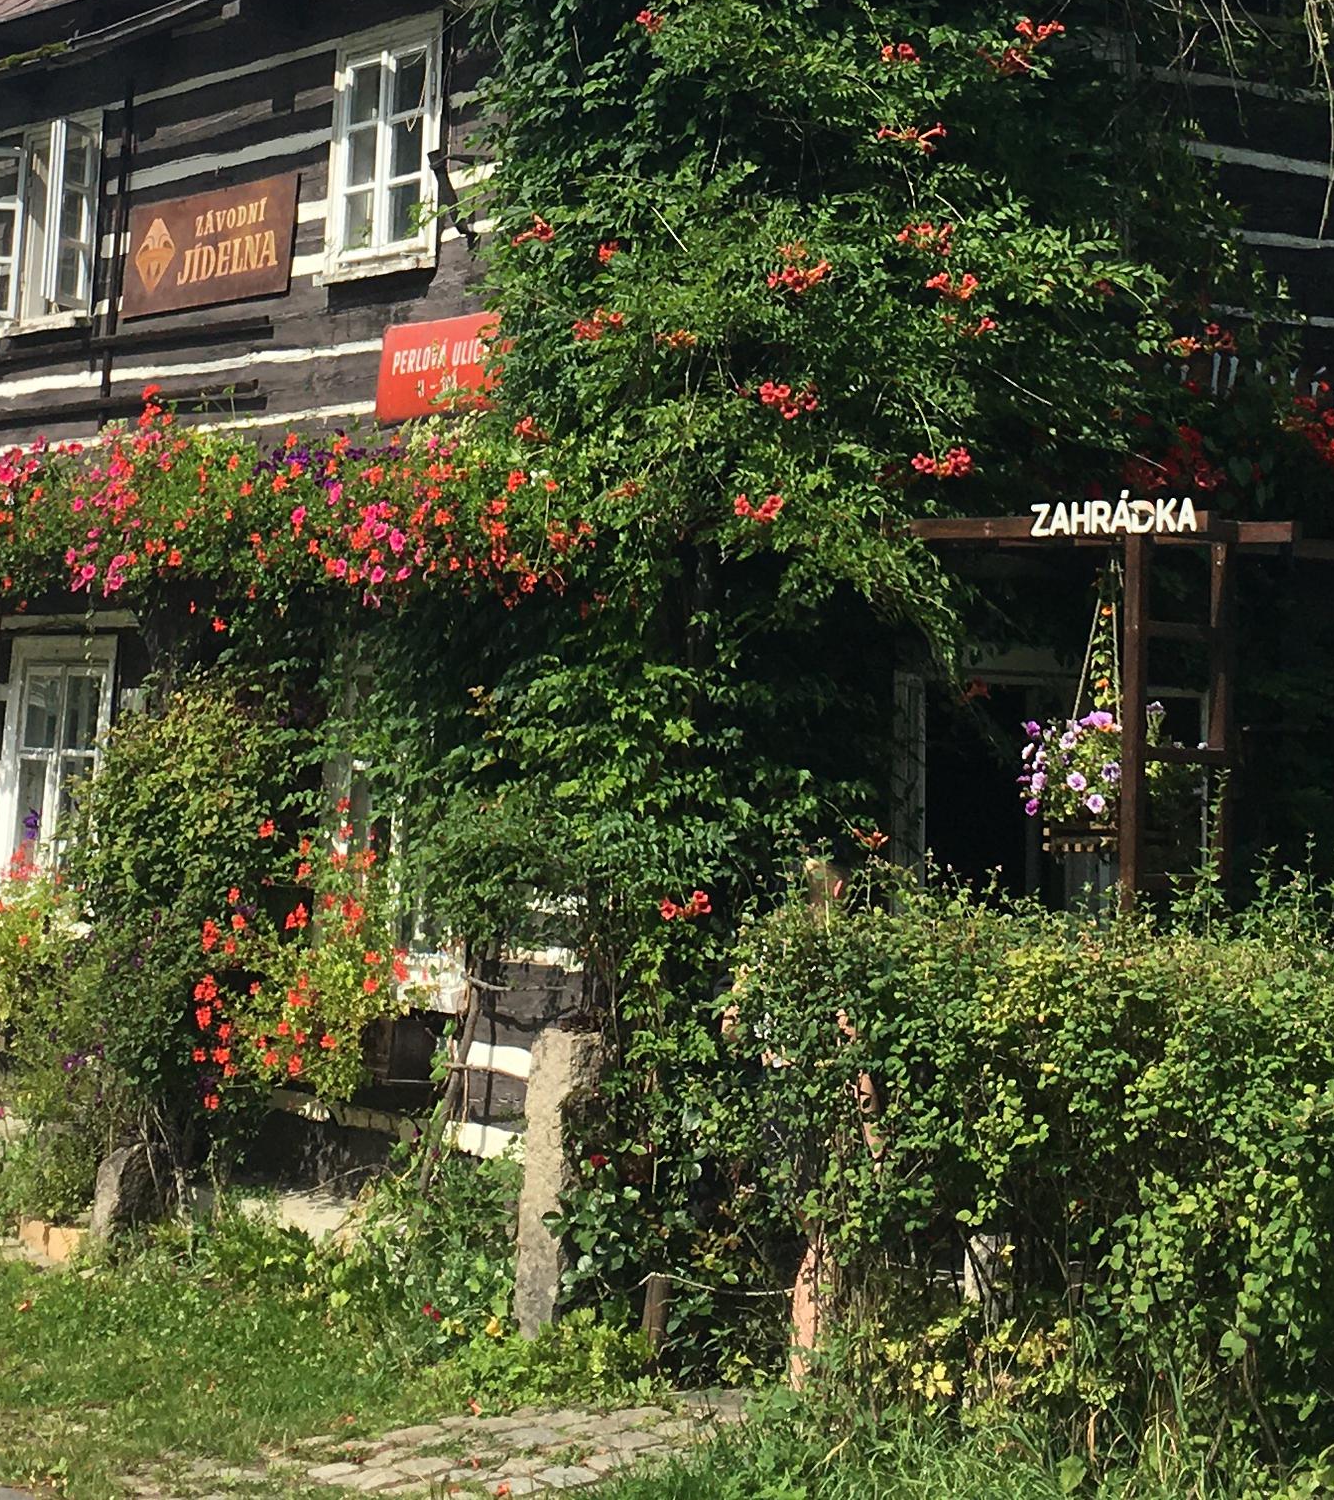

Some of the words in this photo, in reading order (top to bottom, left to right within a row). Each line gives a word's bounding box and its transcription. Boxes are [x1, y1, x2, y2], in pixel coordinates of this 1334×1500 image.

[194, 196, 268, 238] ZÁVODNÍ
[176, 229, 279, 286] JÍDELNA
[1030, 488, 1199, 538] ZAHRÁDKA
